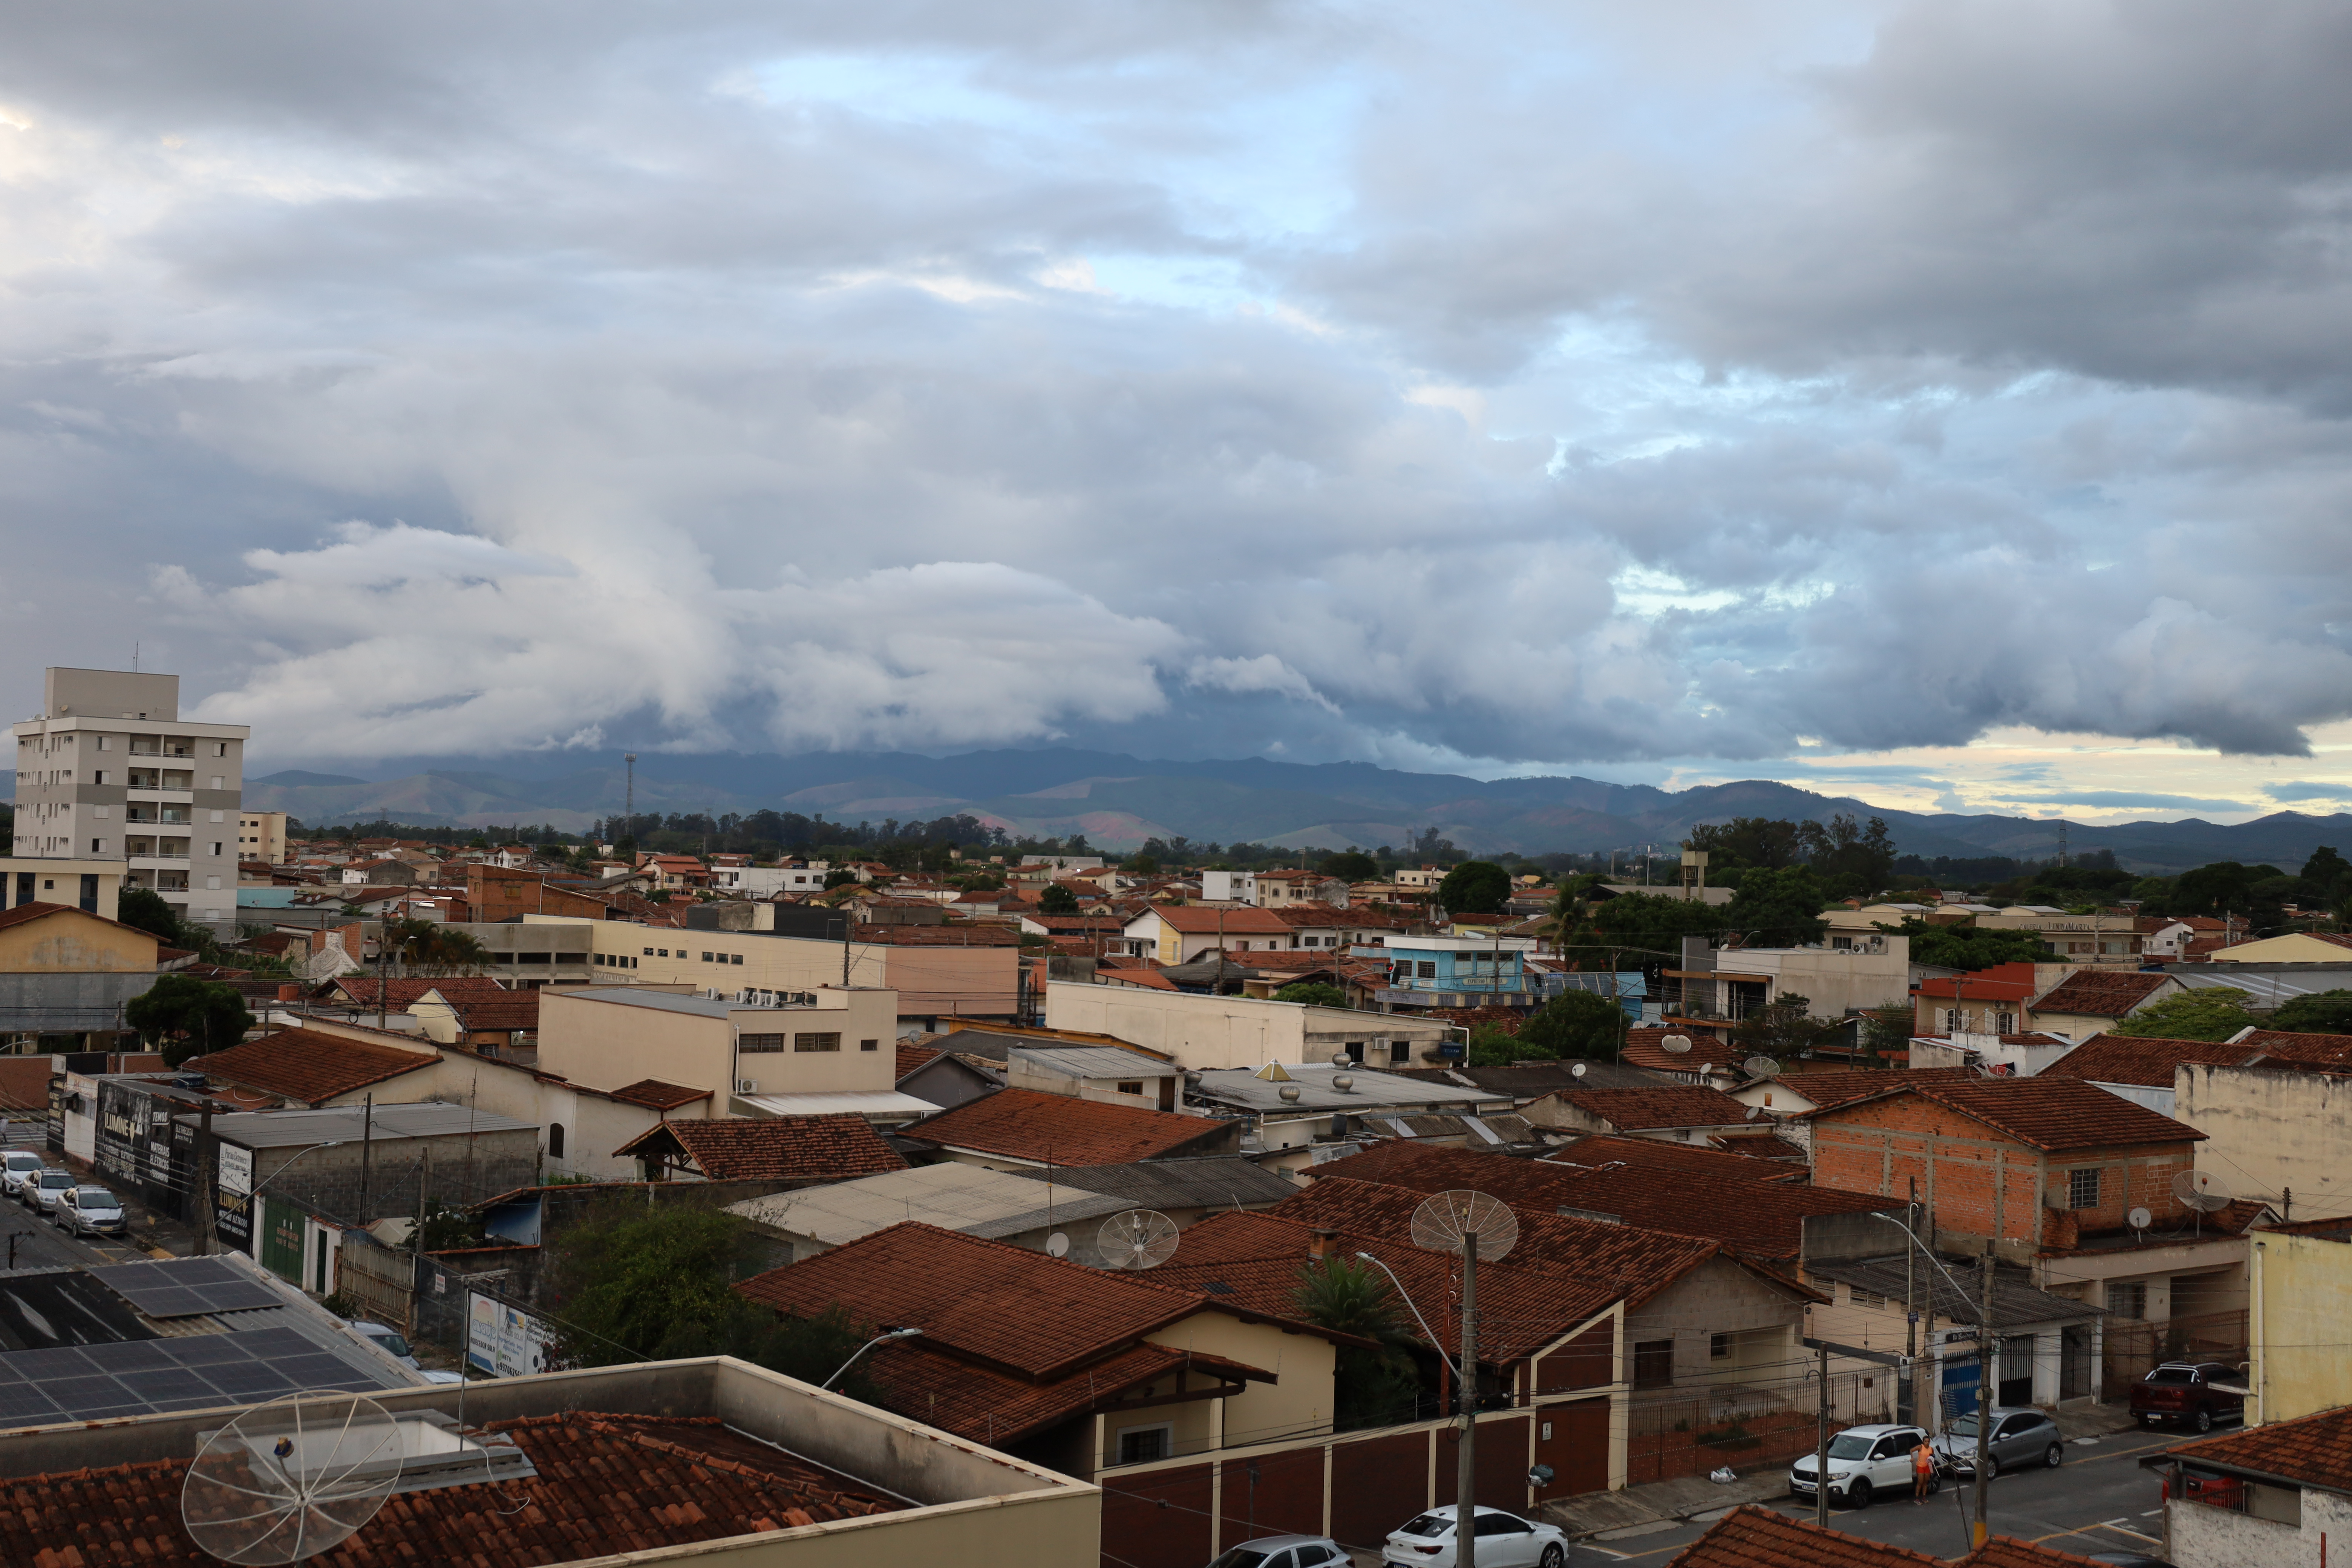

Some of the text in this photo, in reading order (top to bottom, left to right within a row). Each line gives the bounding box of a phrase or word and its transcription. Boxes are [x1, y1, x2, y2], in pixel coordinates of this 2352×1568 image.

[105, 1111, 129, 1136] ILUMINE
[153, 1111, 168, 1122] TEMOS
[150, 1141, 170, 1158] MATERIAIS
[502, 1354, 511, 1362] NETO
